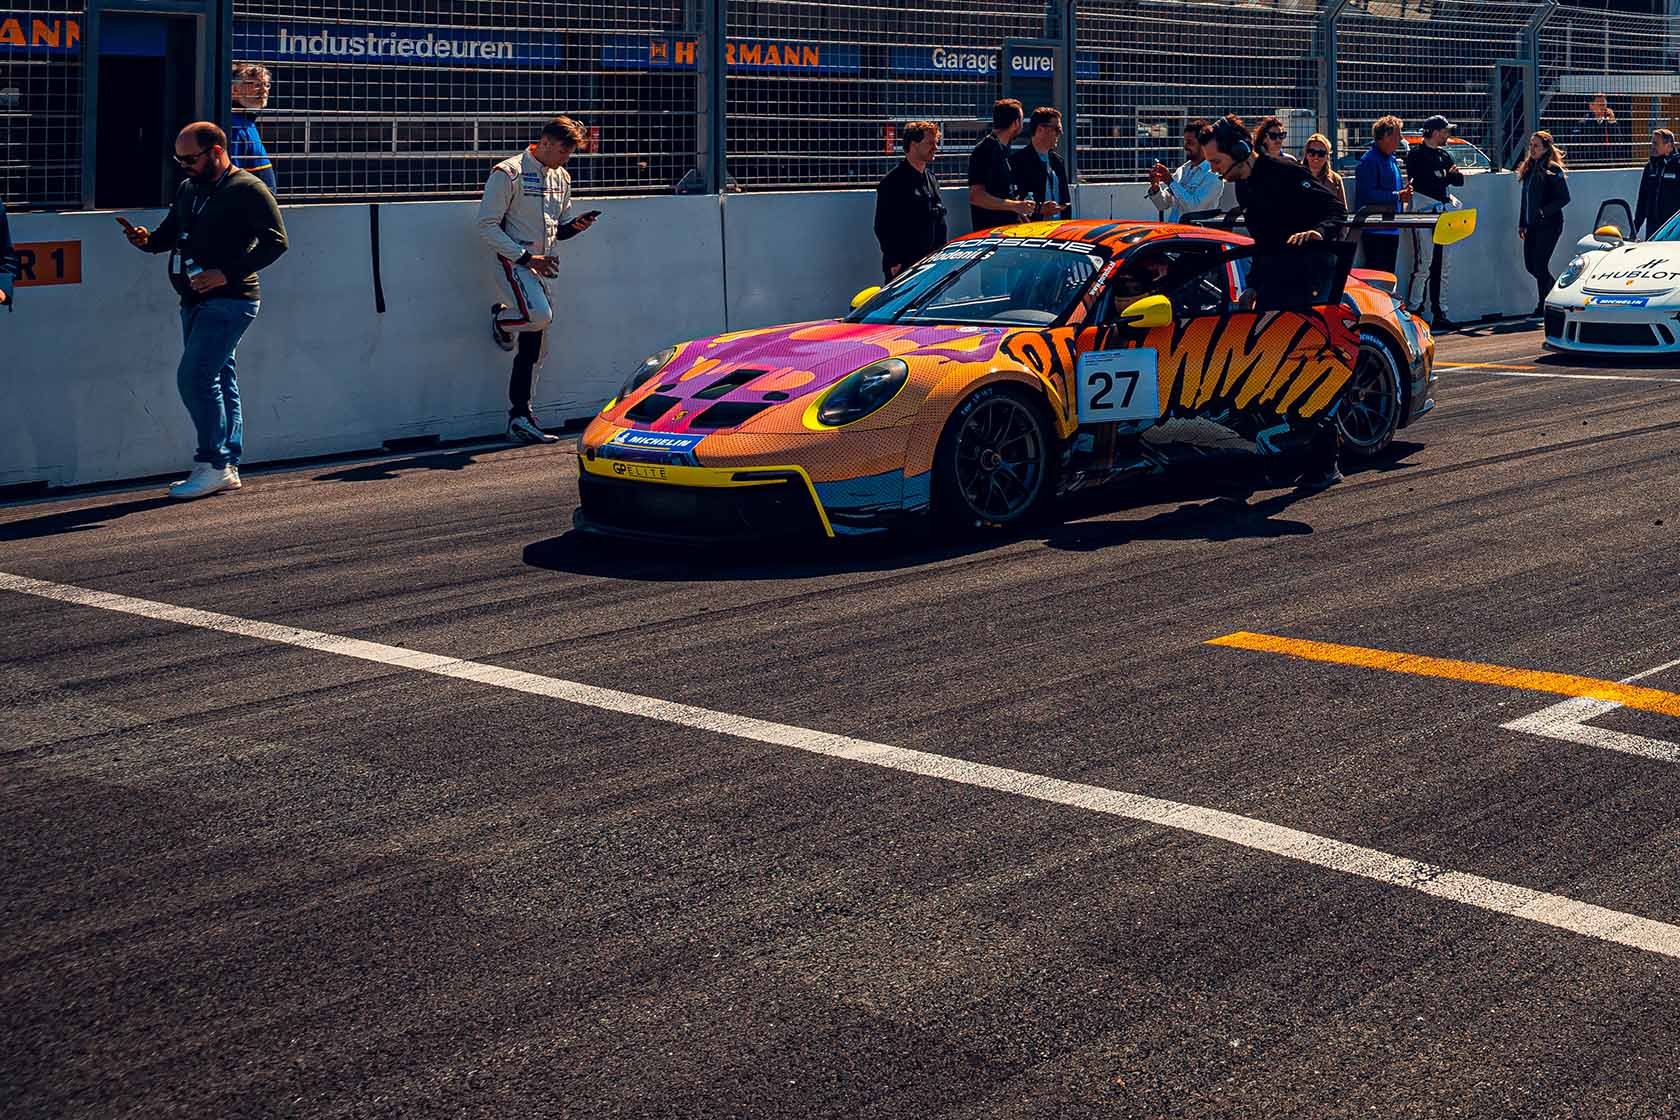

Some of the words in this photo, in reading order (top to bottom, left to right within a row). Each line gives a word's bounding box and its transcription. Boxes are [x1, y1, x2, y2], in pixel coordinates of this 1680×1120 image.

[279, 28, 513, 60] Industriedeuren
[675, 41, 819, 67] HRMANN
[946, 237, 1096, 254] PORSCHE
[1087, 370, 1140, 410] 27
[627, 435, 693, 447] MICHELIN
